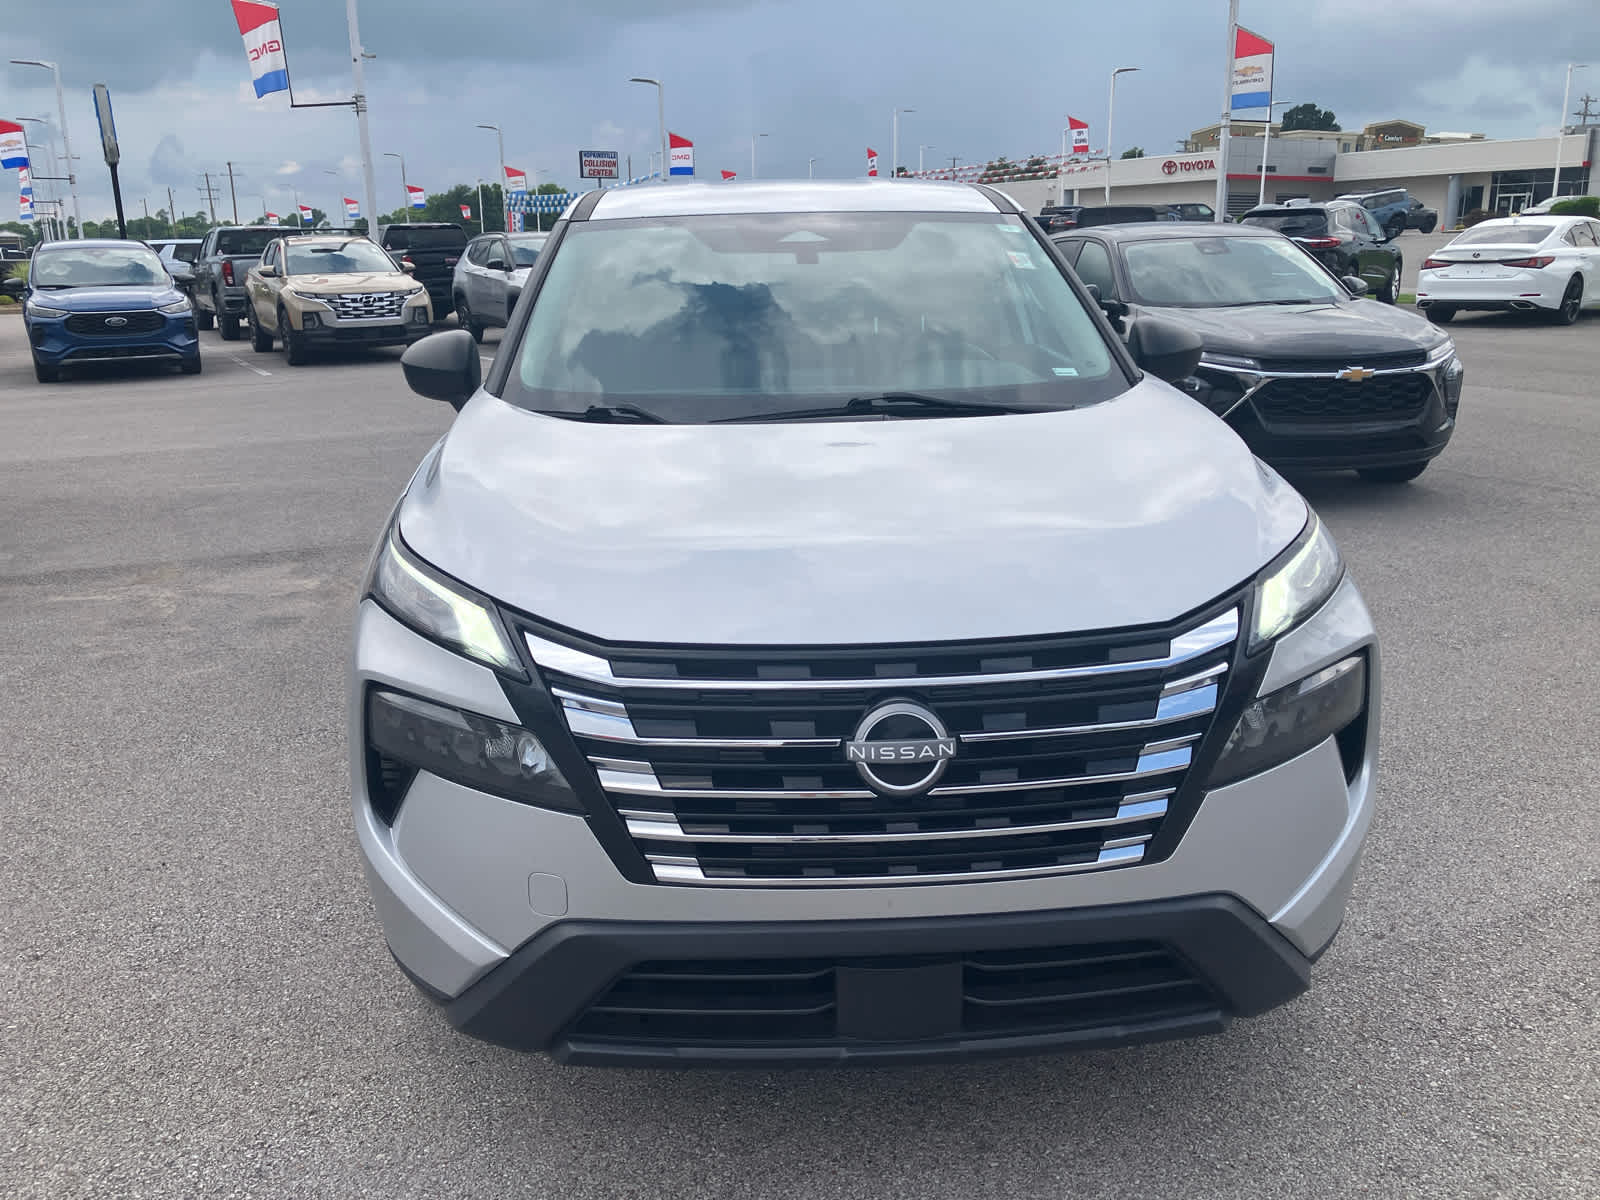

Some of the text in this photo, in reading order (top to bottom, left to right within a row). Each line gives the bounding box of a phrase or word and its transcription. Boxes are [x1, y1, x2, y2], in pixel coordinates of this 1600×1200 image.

[583, 159, 617, 168] COLLISION
[1179, 160, 1216, 172] TOYOTA
[588, 168, 613, 177] CENTER
[849, 742, 954, 760] NISSAN
